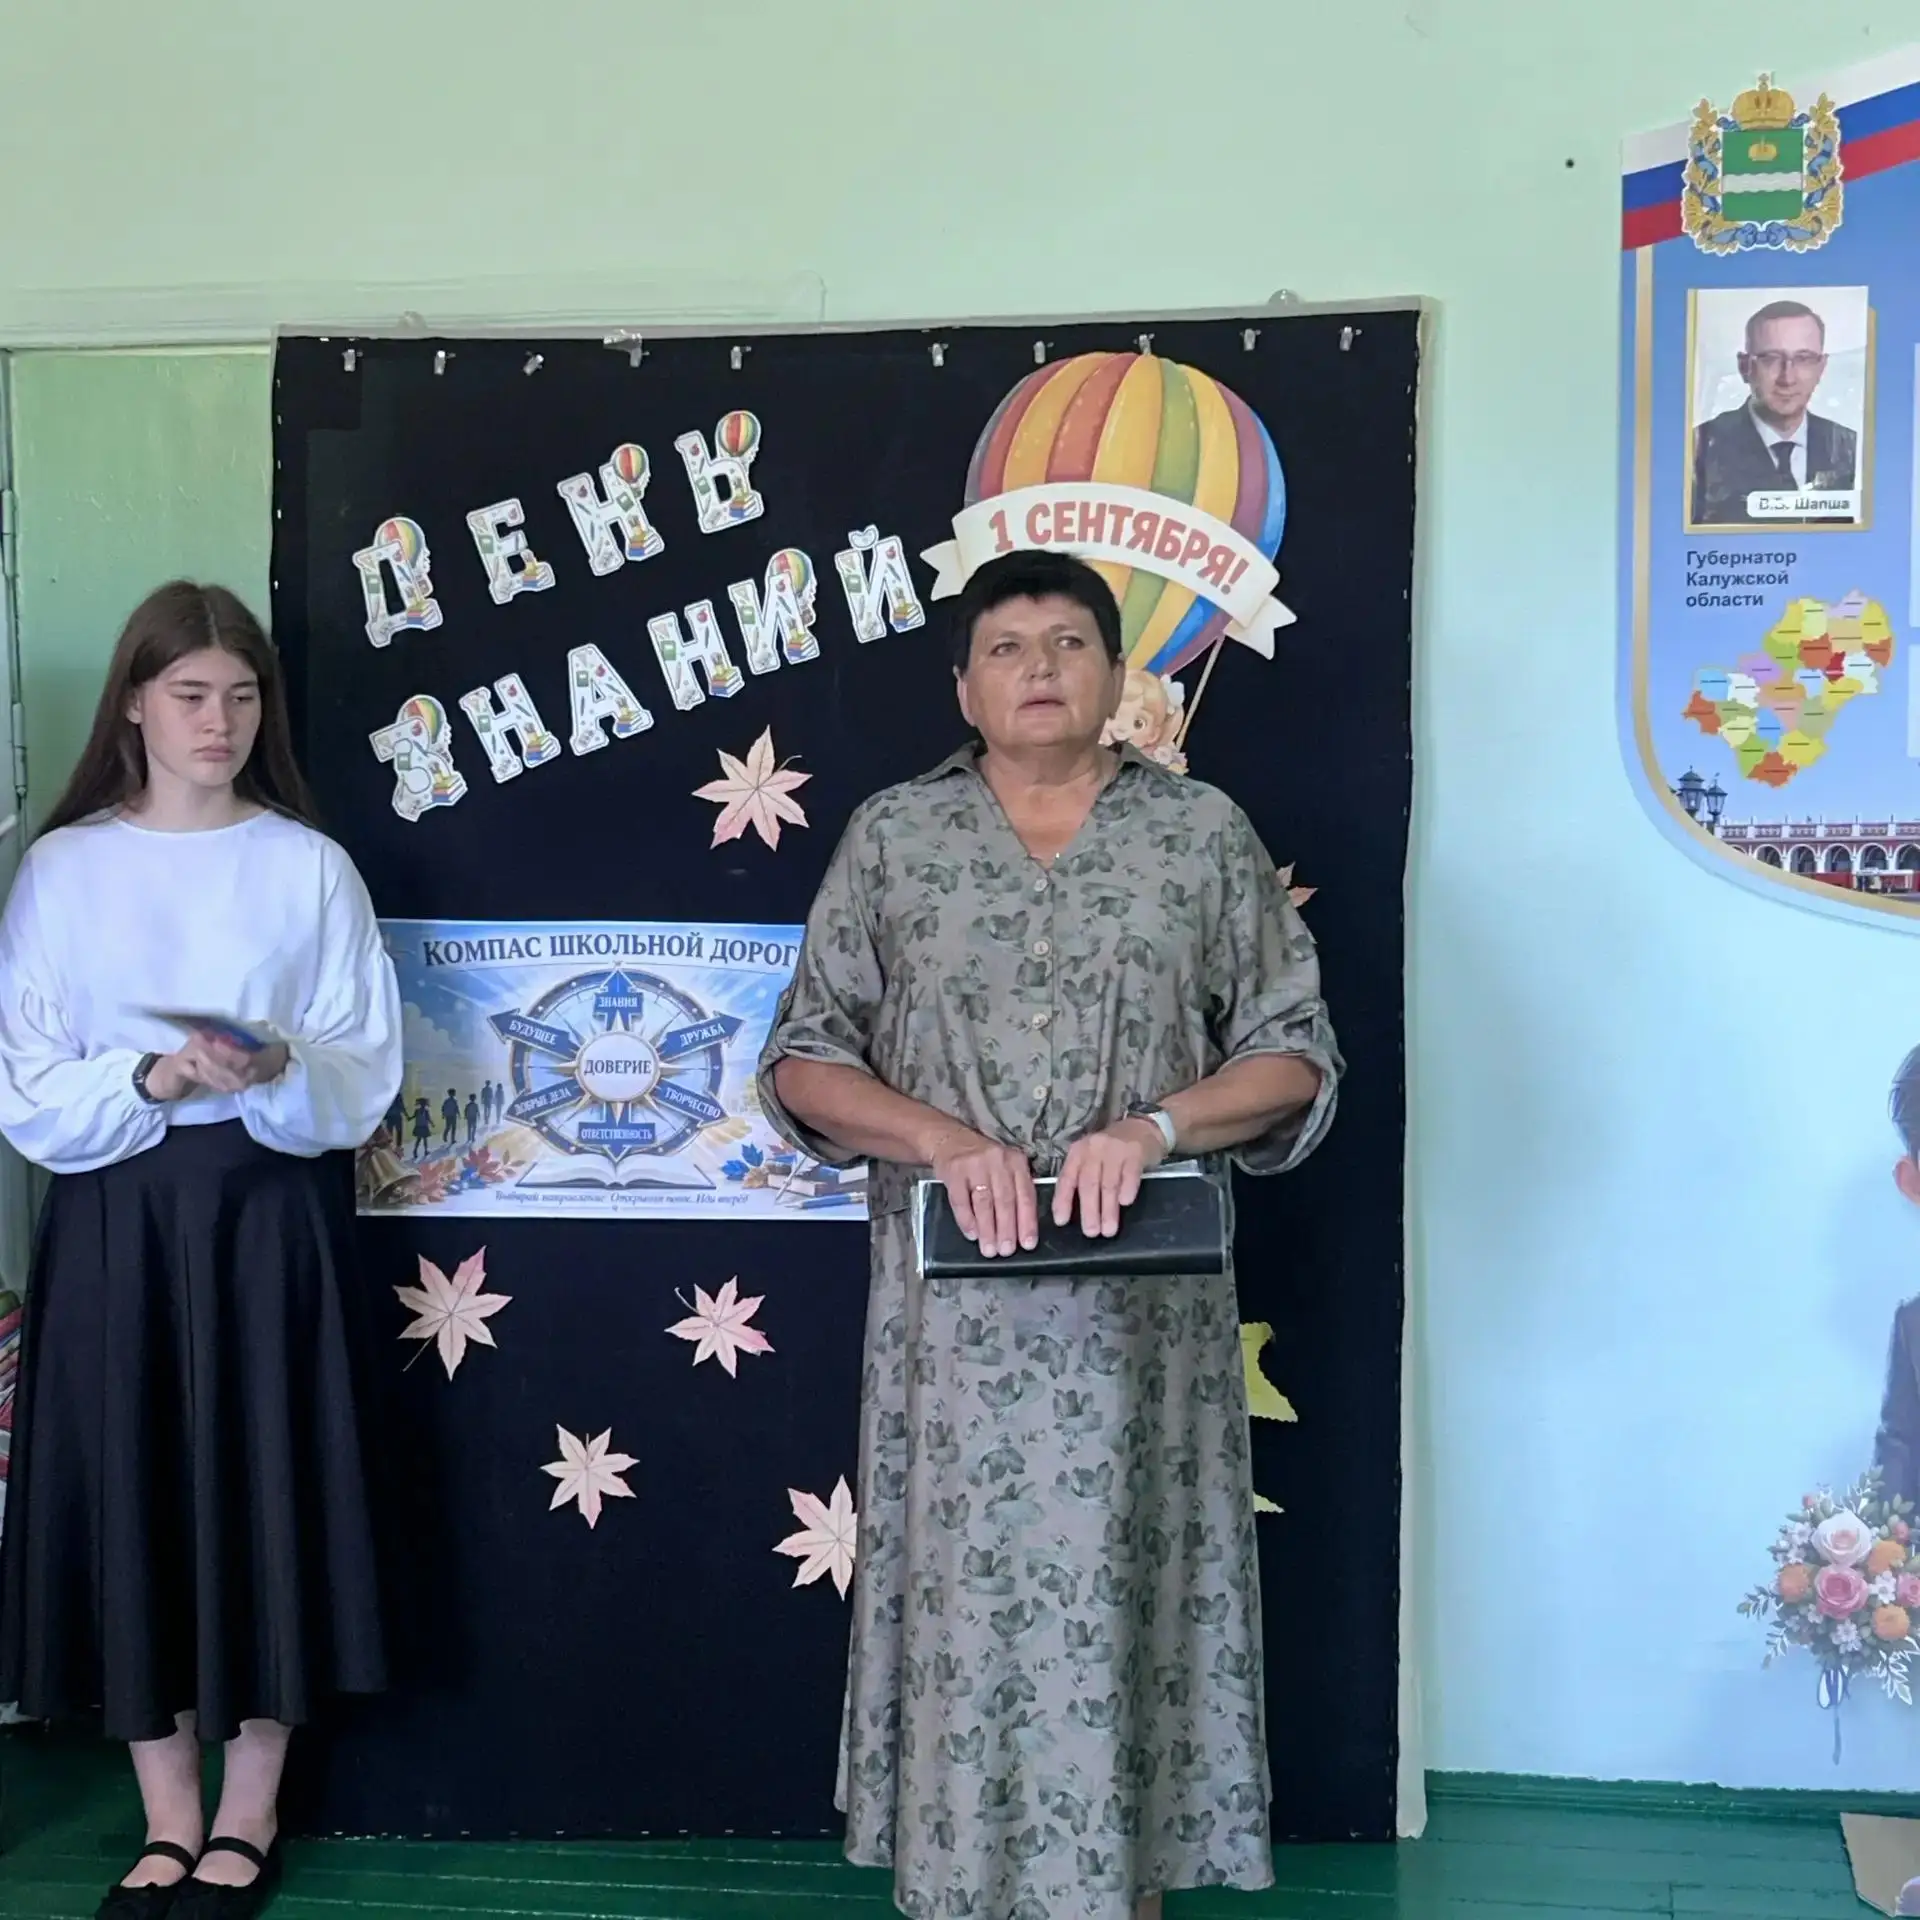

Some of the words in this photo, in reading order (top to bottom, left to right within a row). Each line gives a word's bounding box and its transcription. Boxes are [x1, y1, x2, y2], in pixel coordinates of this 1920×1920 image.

[1795, 498, 1850, 510] Шапша
[352, 410, 764, 648] ДЕНЬ
[989, 510, 1013, 553] 1
[1026, 501, 1249, 595] СЕНТЯБРЯ!
[1687, 551, 1797, 568] Губернатор
[1687, 570, 1789, 589] Калужской
[1686, 593, 1764, 607] области
[369, 525, 925, 822] ЗНАНИЙ
[423, 937, 542, 967] КОМПАС
[550, 931, 704, 958] ШКОЛЬНОЙ
[709, 938, 799, 967] ДОРОГ
[509, 1019, 558, 1046] БУДУЩЕЕ
[680, 1023, 726, 1048] ДРУЖБА
[584, 1060, 652, 1076] ДОВЕРИЕ
[665, 1087, 721, 1119] ТВОРЧЕСТВО
